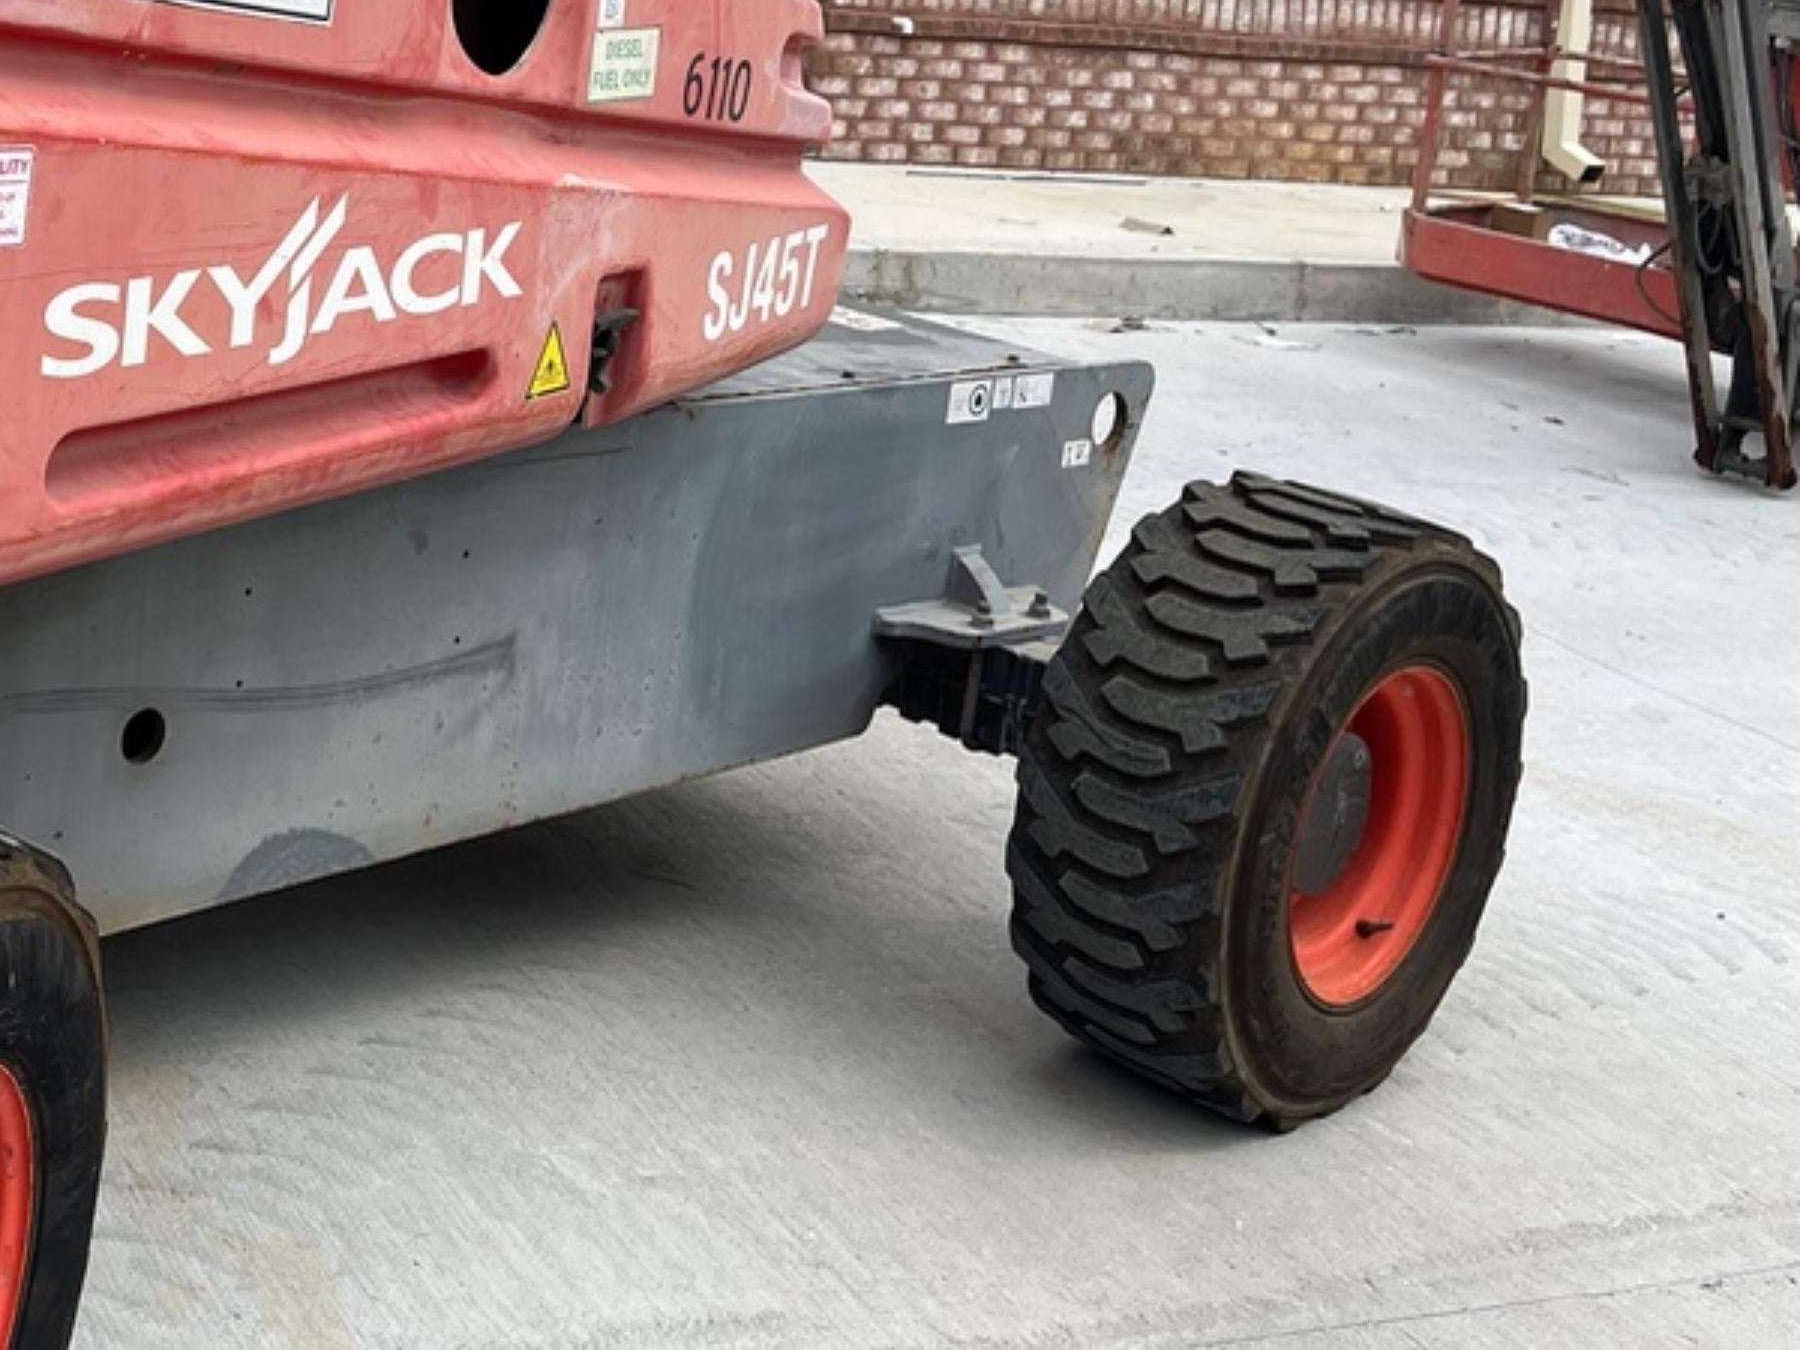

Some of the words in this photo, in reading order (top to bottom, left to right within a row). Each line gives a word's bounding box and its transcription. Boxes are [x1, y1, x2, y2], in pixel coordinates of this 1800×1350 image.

[593, 69, 621, 92] FUEL
[623, 68, 652, 88] ONLY
[605, 38, 644, 61] DIESEL
[683, 52, 752, 123] 6110
[41, 194, 524, 380] SKYJACK
[704, 224, 831, 342] SJ45T
